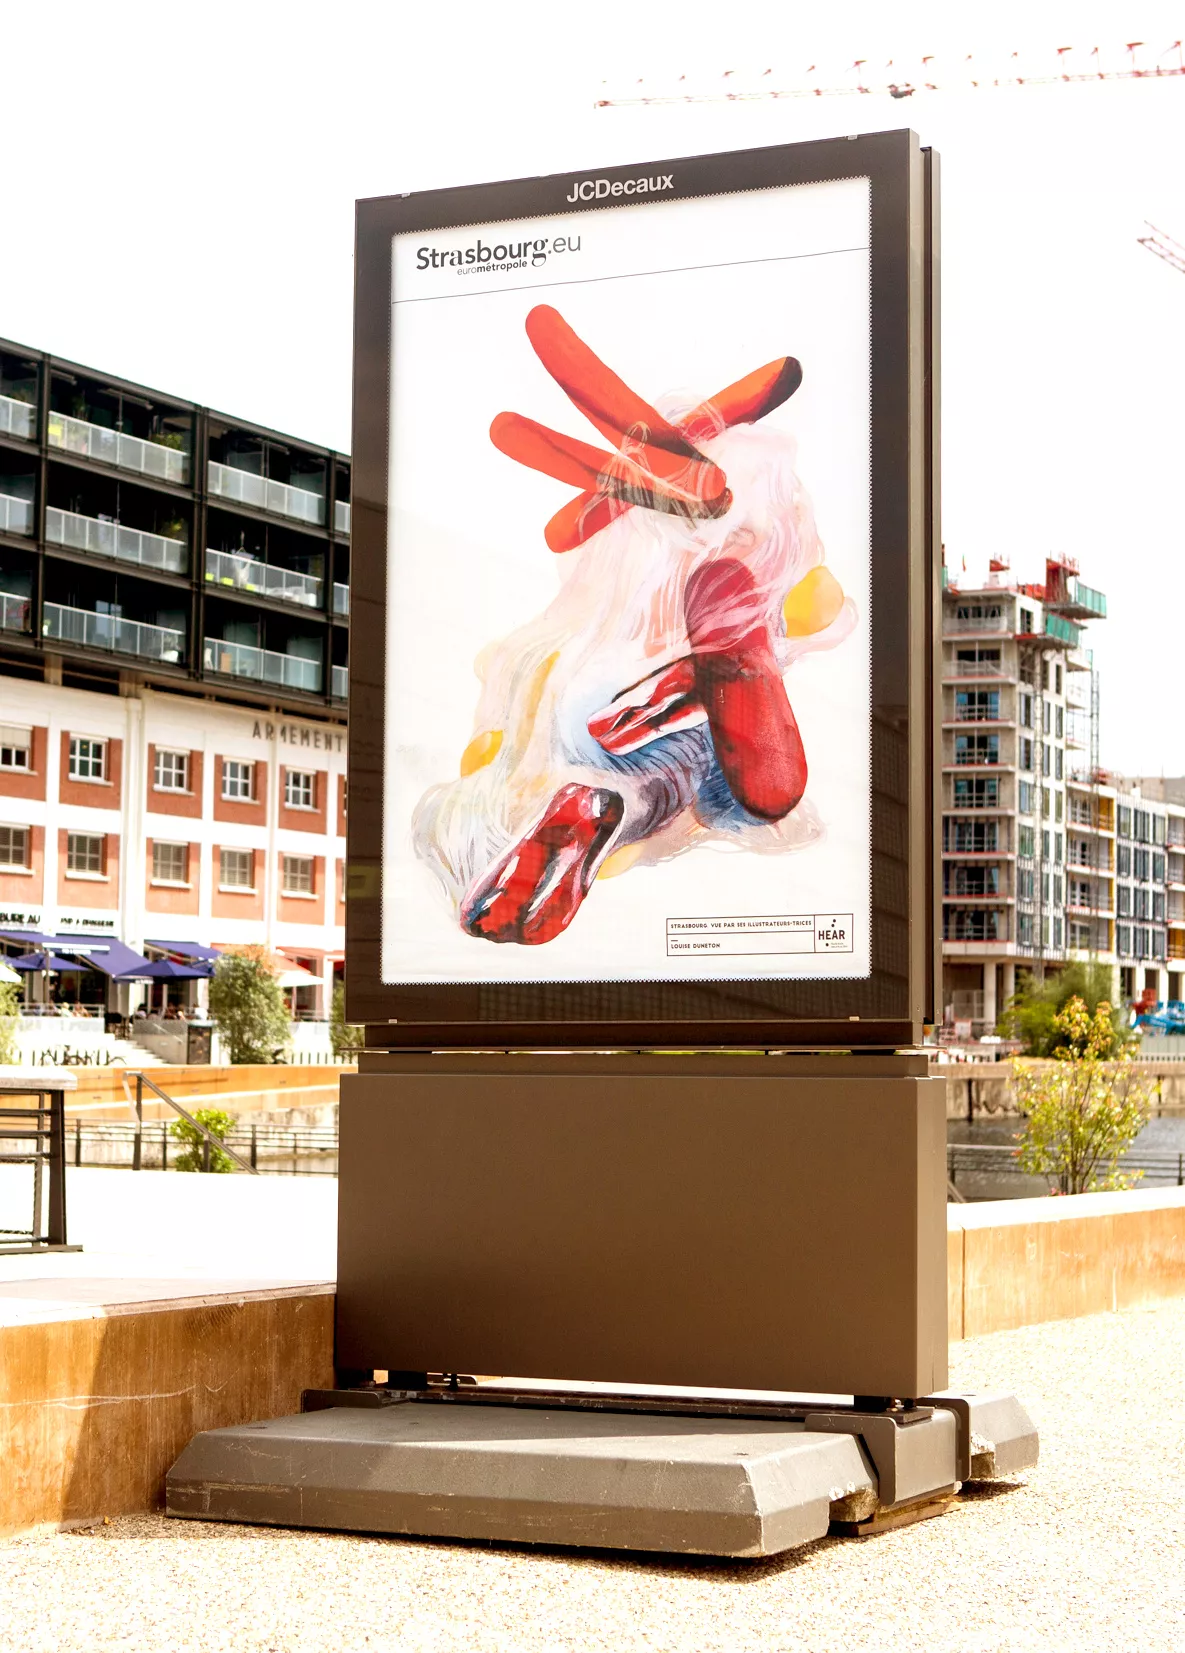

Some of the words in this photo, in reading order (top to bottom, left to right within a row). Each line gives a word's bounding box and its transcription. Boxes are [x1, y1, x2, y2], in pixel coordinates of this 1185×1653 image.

[566, 174, 674, 202] JCDecaux
[416, 235, 581, 270] Strasbourg.eu
[457, 259, 527, 275] eurométropole
[818, 929, 846, 940] HEAR
